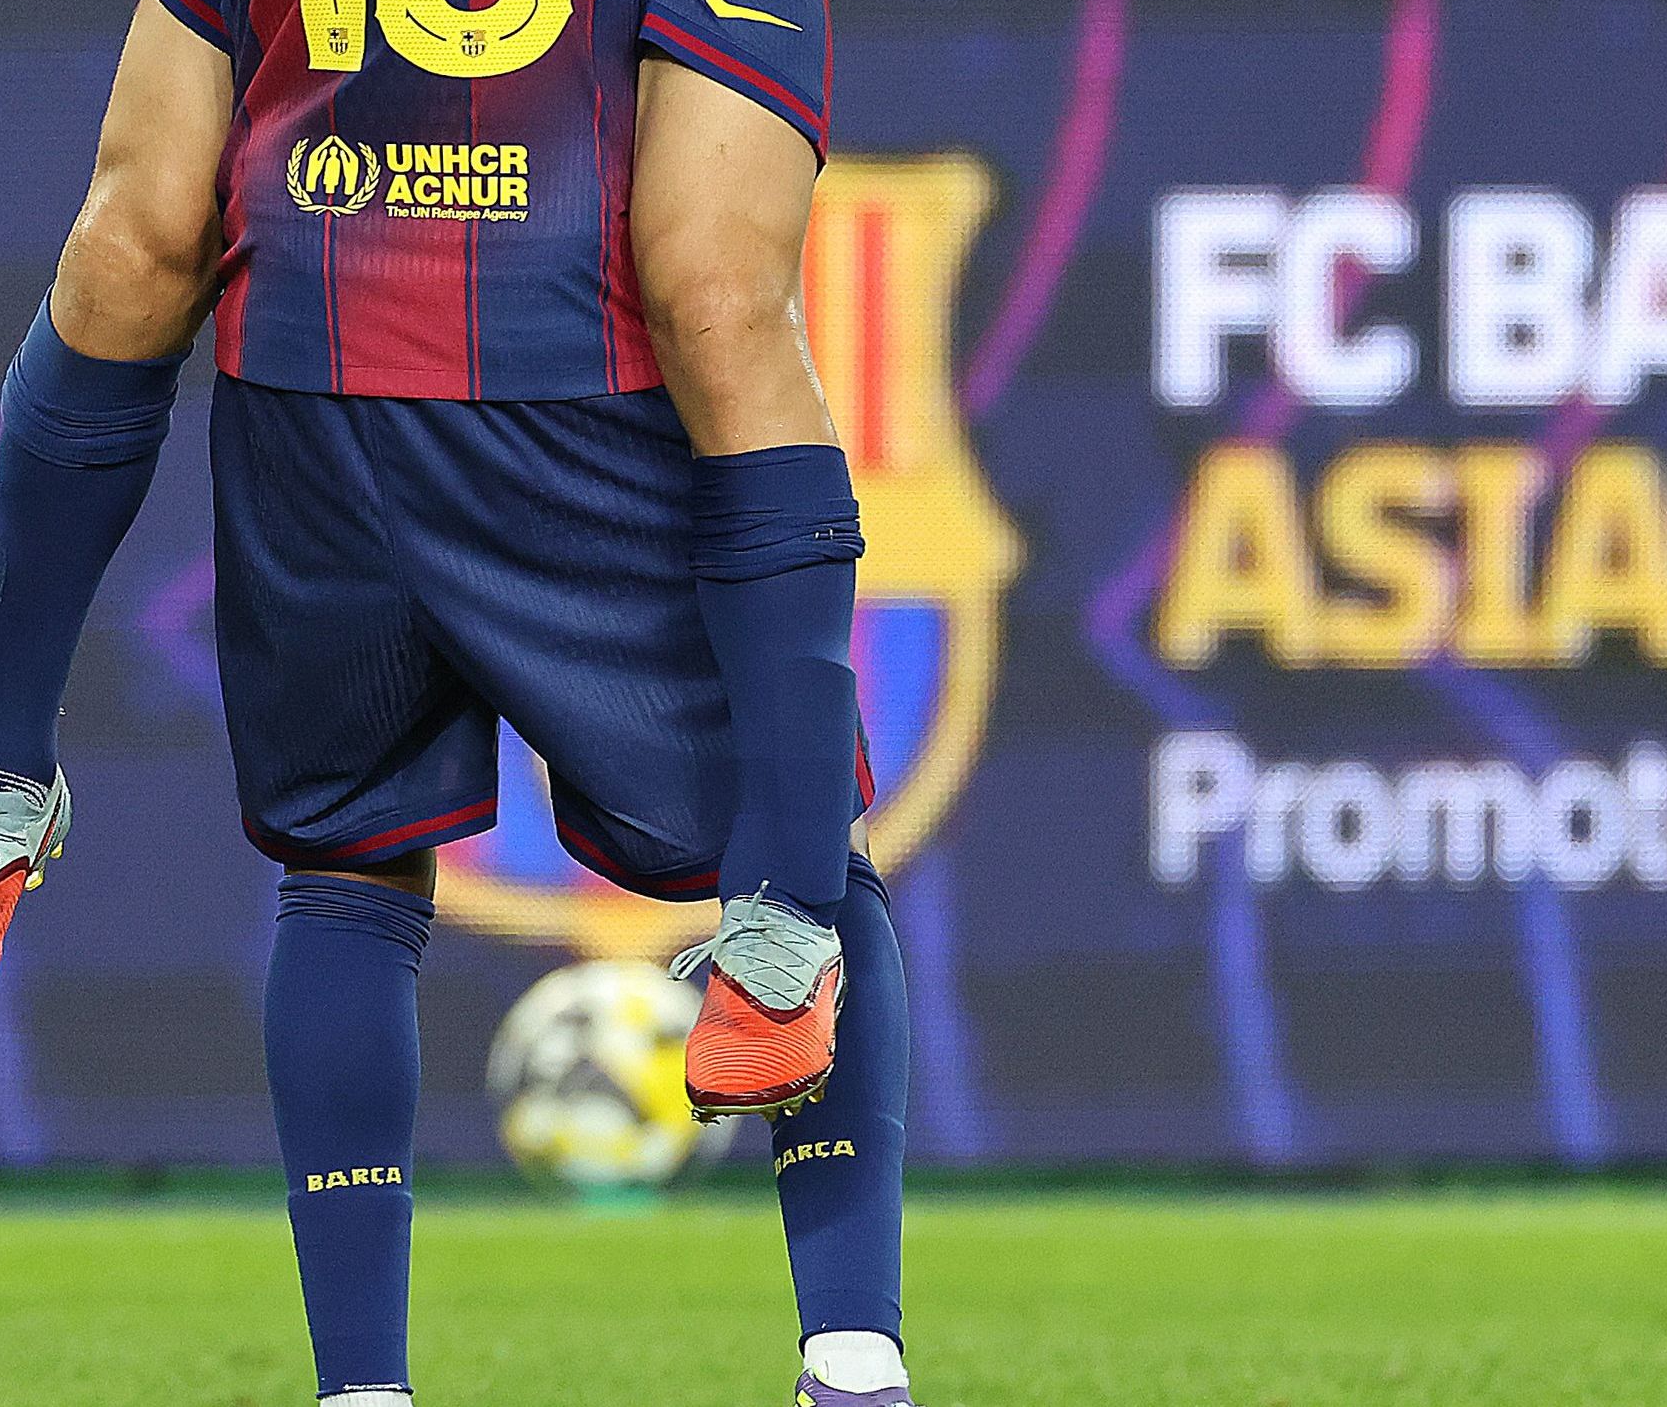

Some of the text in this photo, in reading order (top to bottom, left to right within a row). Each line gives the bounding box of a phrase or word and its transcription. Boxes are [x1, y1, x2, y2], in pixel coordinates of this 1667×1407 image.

[386, 143, 529, 175] UNHCR
[385, 174, 529, 207] ACNUR
[385, 205, 529, 222] The UN Refugee Agency
[1150, 186, 1421, 409] FC
[774, 1139, 856, 1178] BARÇA
[306, 1166, 403, 1193] BARÇA
